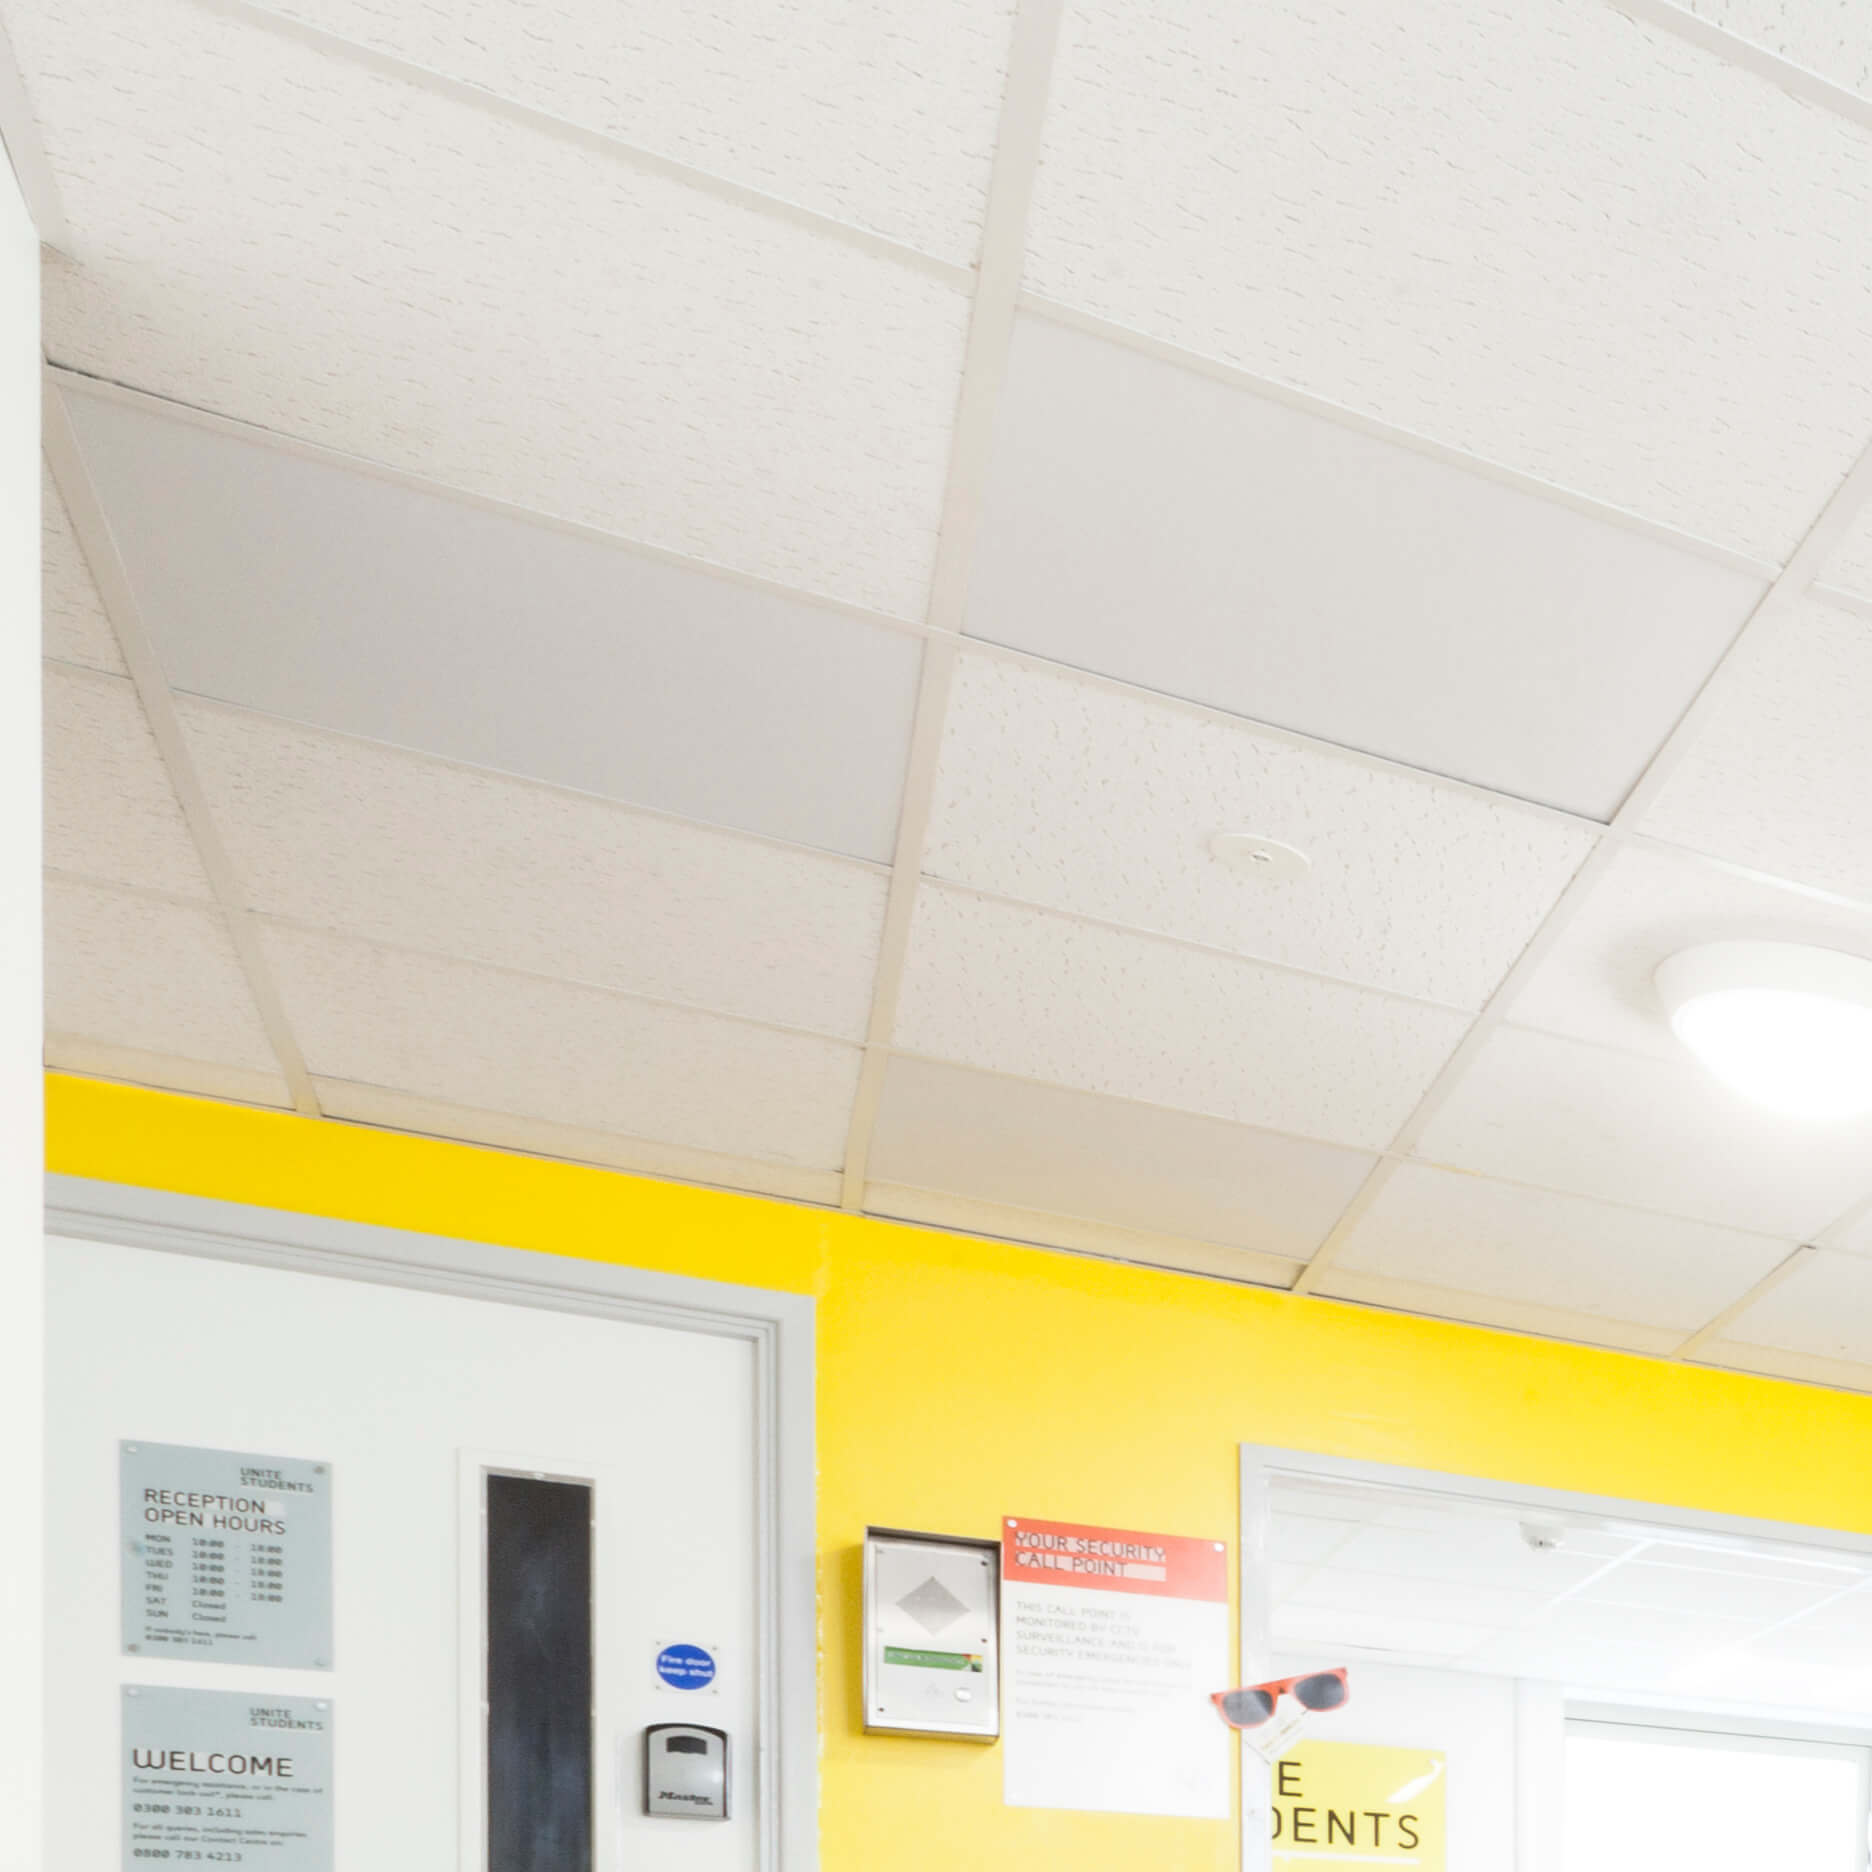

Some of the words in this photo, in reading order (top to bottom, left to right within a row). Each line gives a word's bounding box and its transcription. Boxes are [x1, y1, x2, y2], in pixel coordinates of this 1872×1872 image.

[240, 1467, 282, 1480] UNITE
[240, 1477, 314, 1493] STUDENTS
[145, 1488, 265, 1514] RECEPTION
[145, 1507, 204, 1527] OPEN
[213, 1515, 286, 1535] HOURS
[145, 1534, 171, 1543] MON
[1015, 1530, 1068, 1551] YOUR
[1076, 1539, 1166, 1562] SECURITY
[1015, 1551, 1064, 1570] CALL
[1072, 1557, 1128, 1577] POINT
[249, 1707, 292, 1719] UNITE
[249, 1717, 324, 1731] STUDENTS
[133, 1748, 294, 1777] WELCOME
